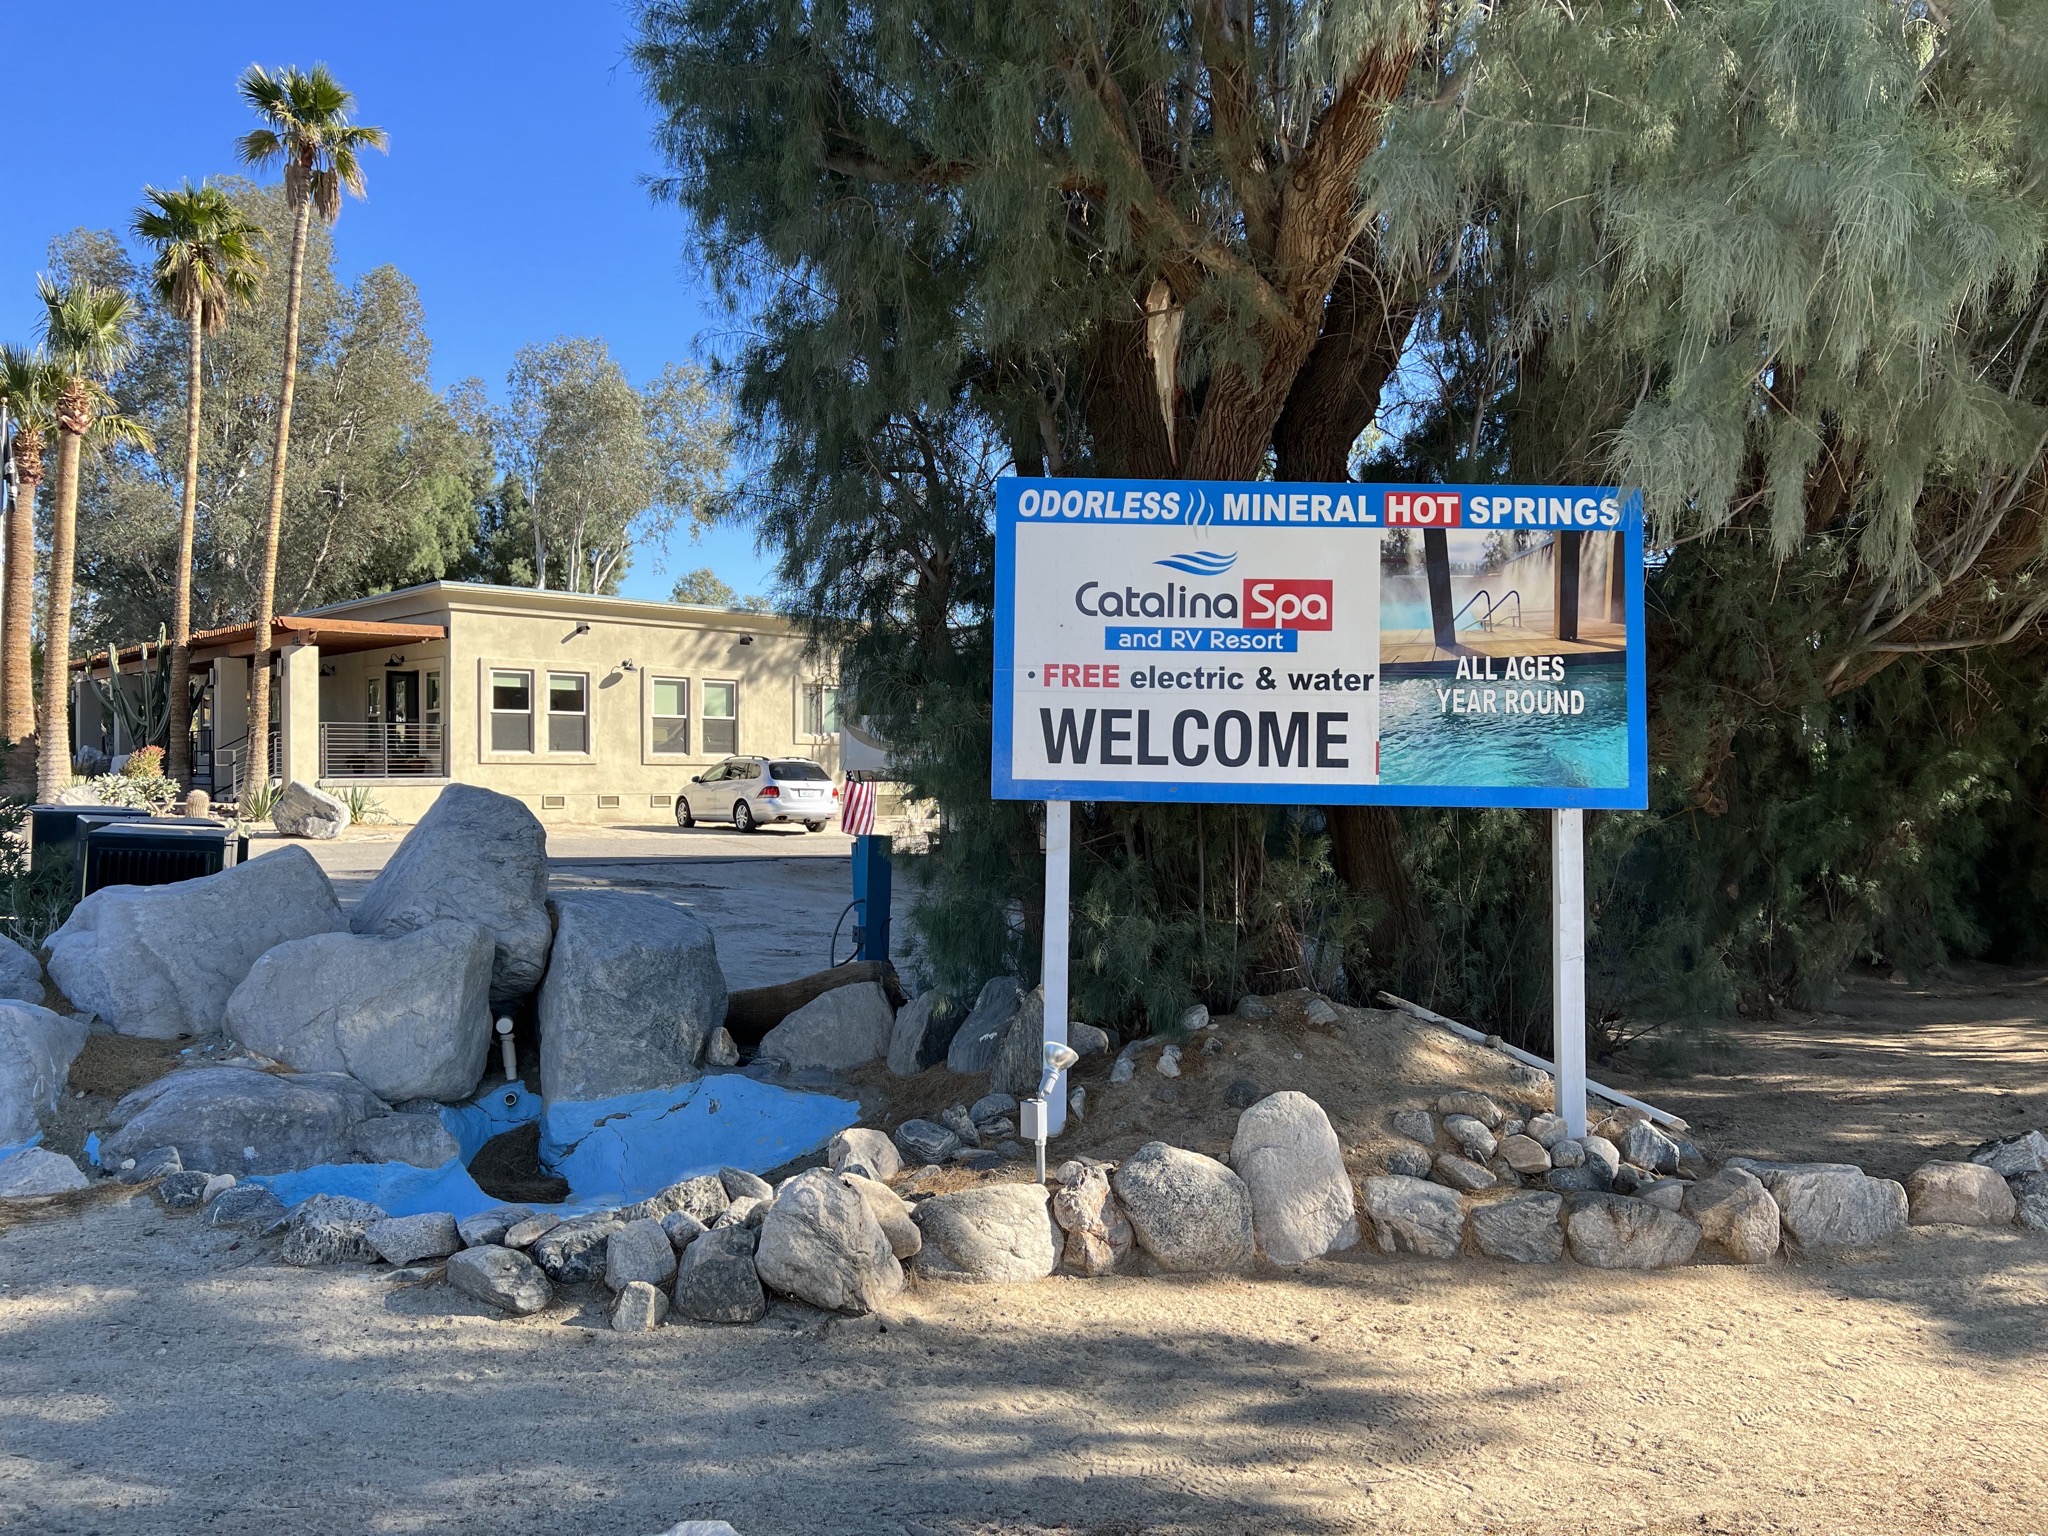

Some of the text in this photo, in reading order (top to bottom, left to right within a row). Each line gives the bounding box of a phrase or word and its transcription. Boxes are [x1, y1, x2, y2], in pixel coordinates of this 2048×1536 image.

[1018, 489, 1621, 526] ODORLESS MINERAL HOT SPRINGS
[1075, 581, 1328, 630] Catalina Spa
[1118, 629, 1284, 650] and RV Resort
[1043, 663, 1374, 693] FREE electric & water
[1456, 655, 1566, 682] ALL AGES
[1436, 688, 1585, 715] YEAR ROUND
[1039, 707, 1349, 769] WELCOME
